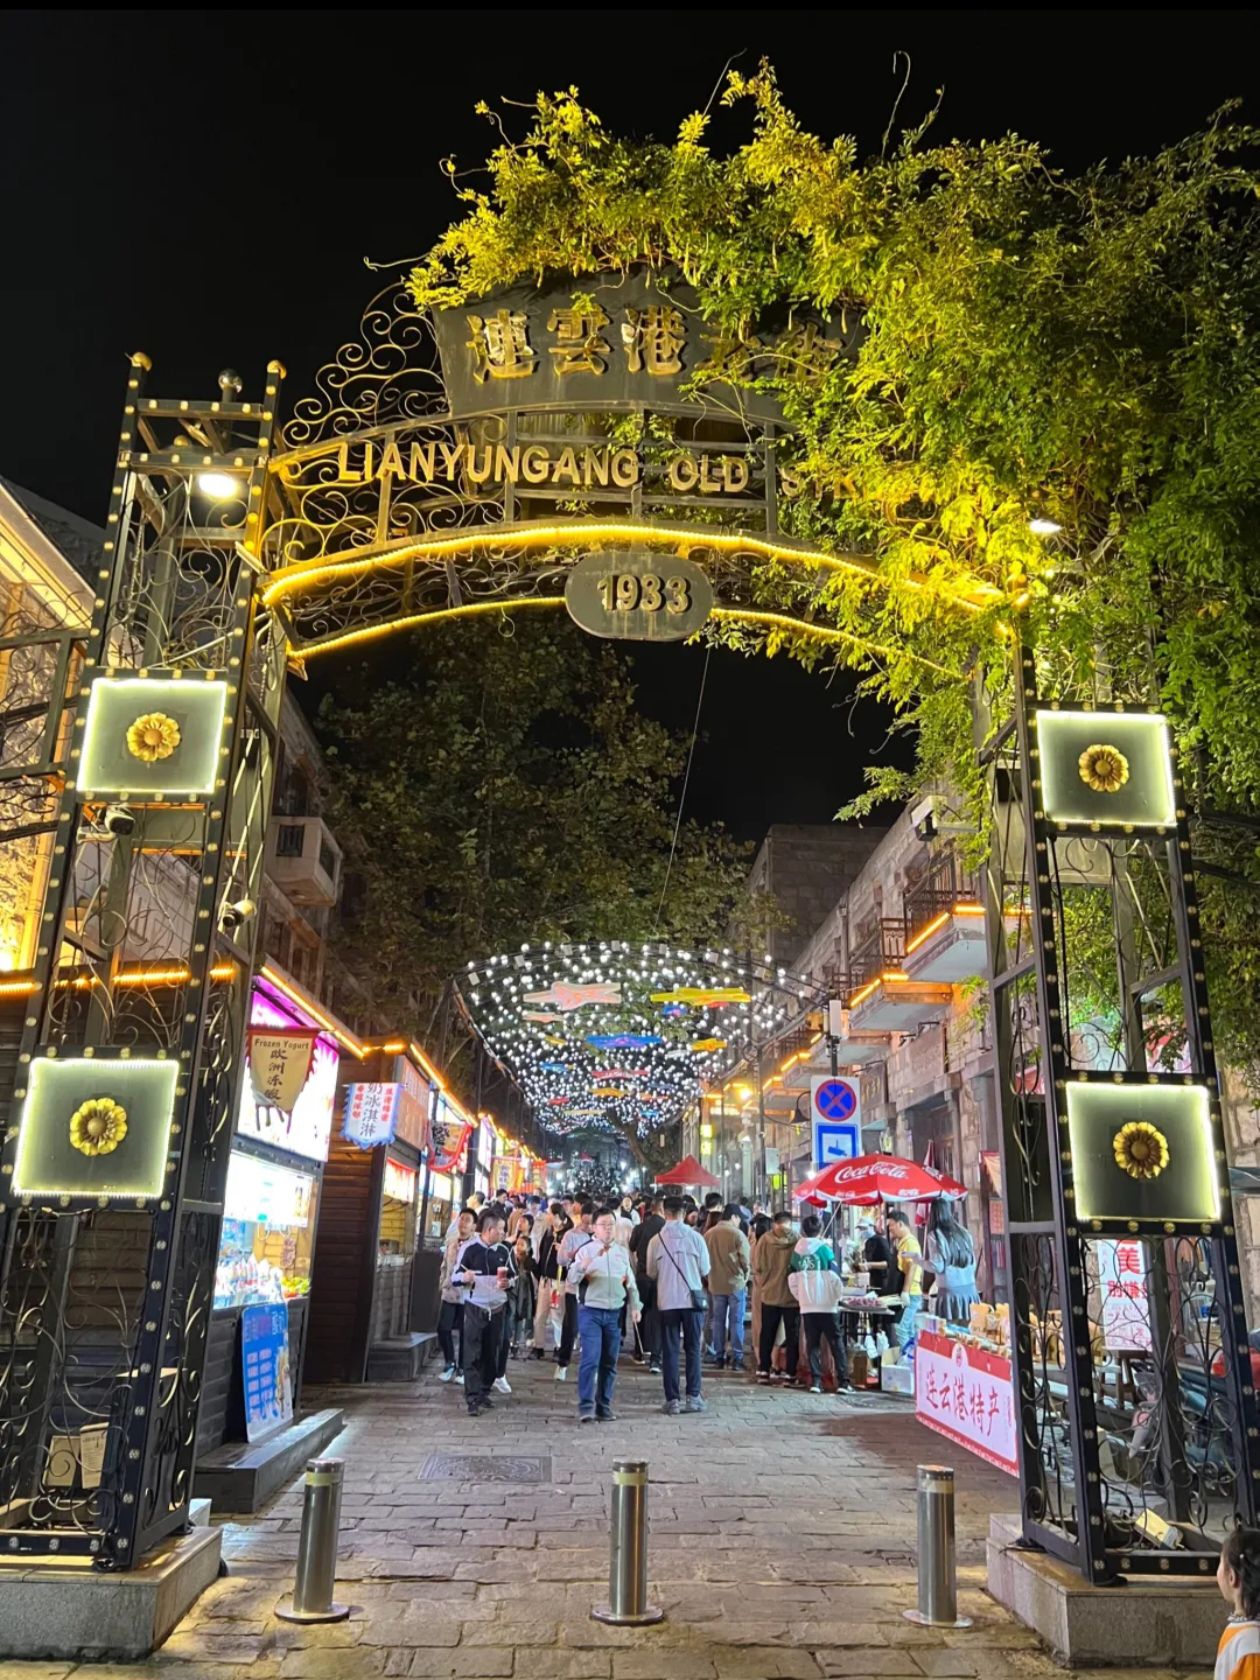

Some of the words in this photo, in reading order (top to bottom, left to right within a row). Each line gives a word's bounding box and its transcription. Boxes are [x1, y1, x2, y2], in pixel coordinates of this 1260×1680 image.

[337, 440, 642, 488] LIANYUNGANG
[669, 454, 750, 493] OLD
[597, 573, 692, 614] 1933
[254, 1038, 281, 1048] Frozen
[283, 1040, 310, 1050] Yogurt
[926, 1363, 1000, 1437] 连云港特产
